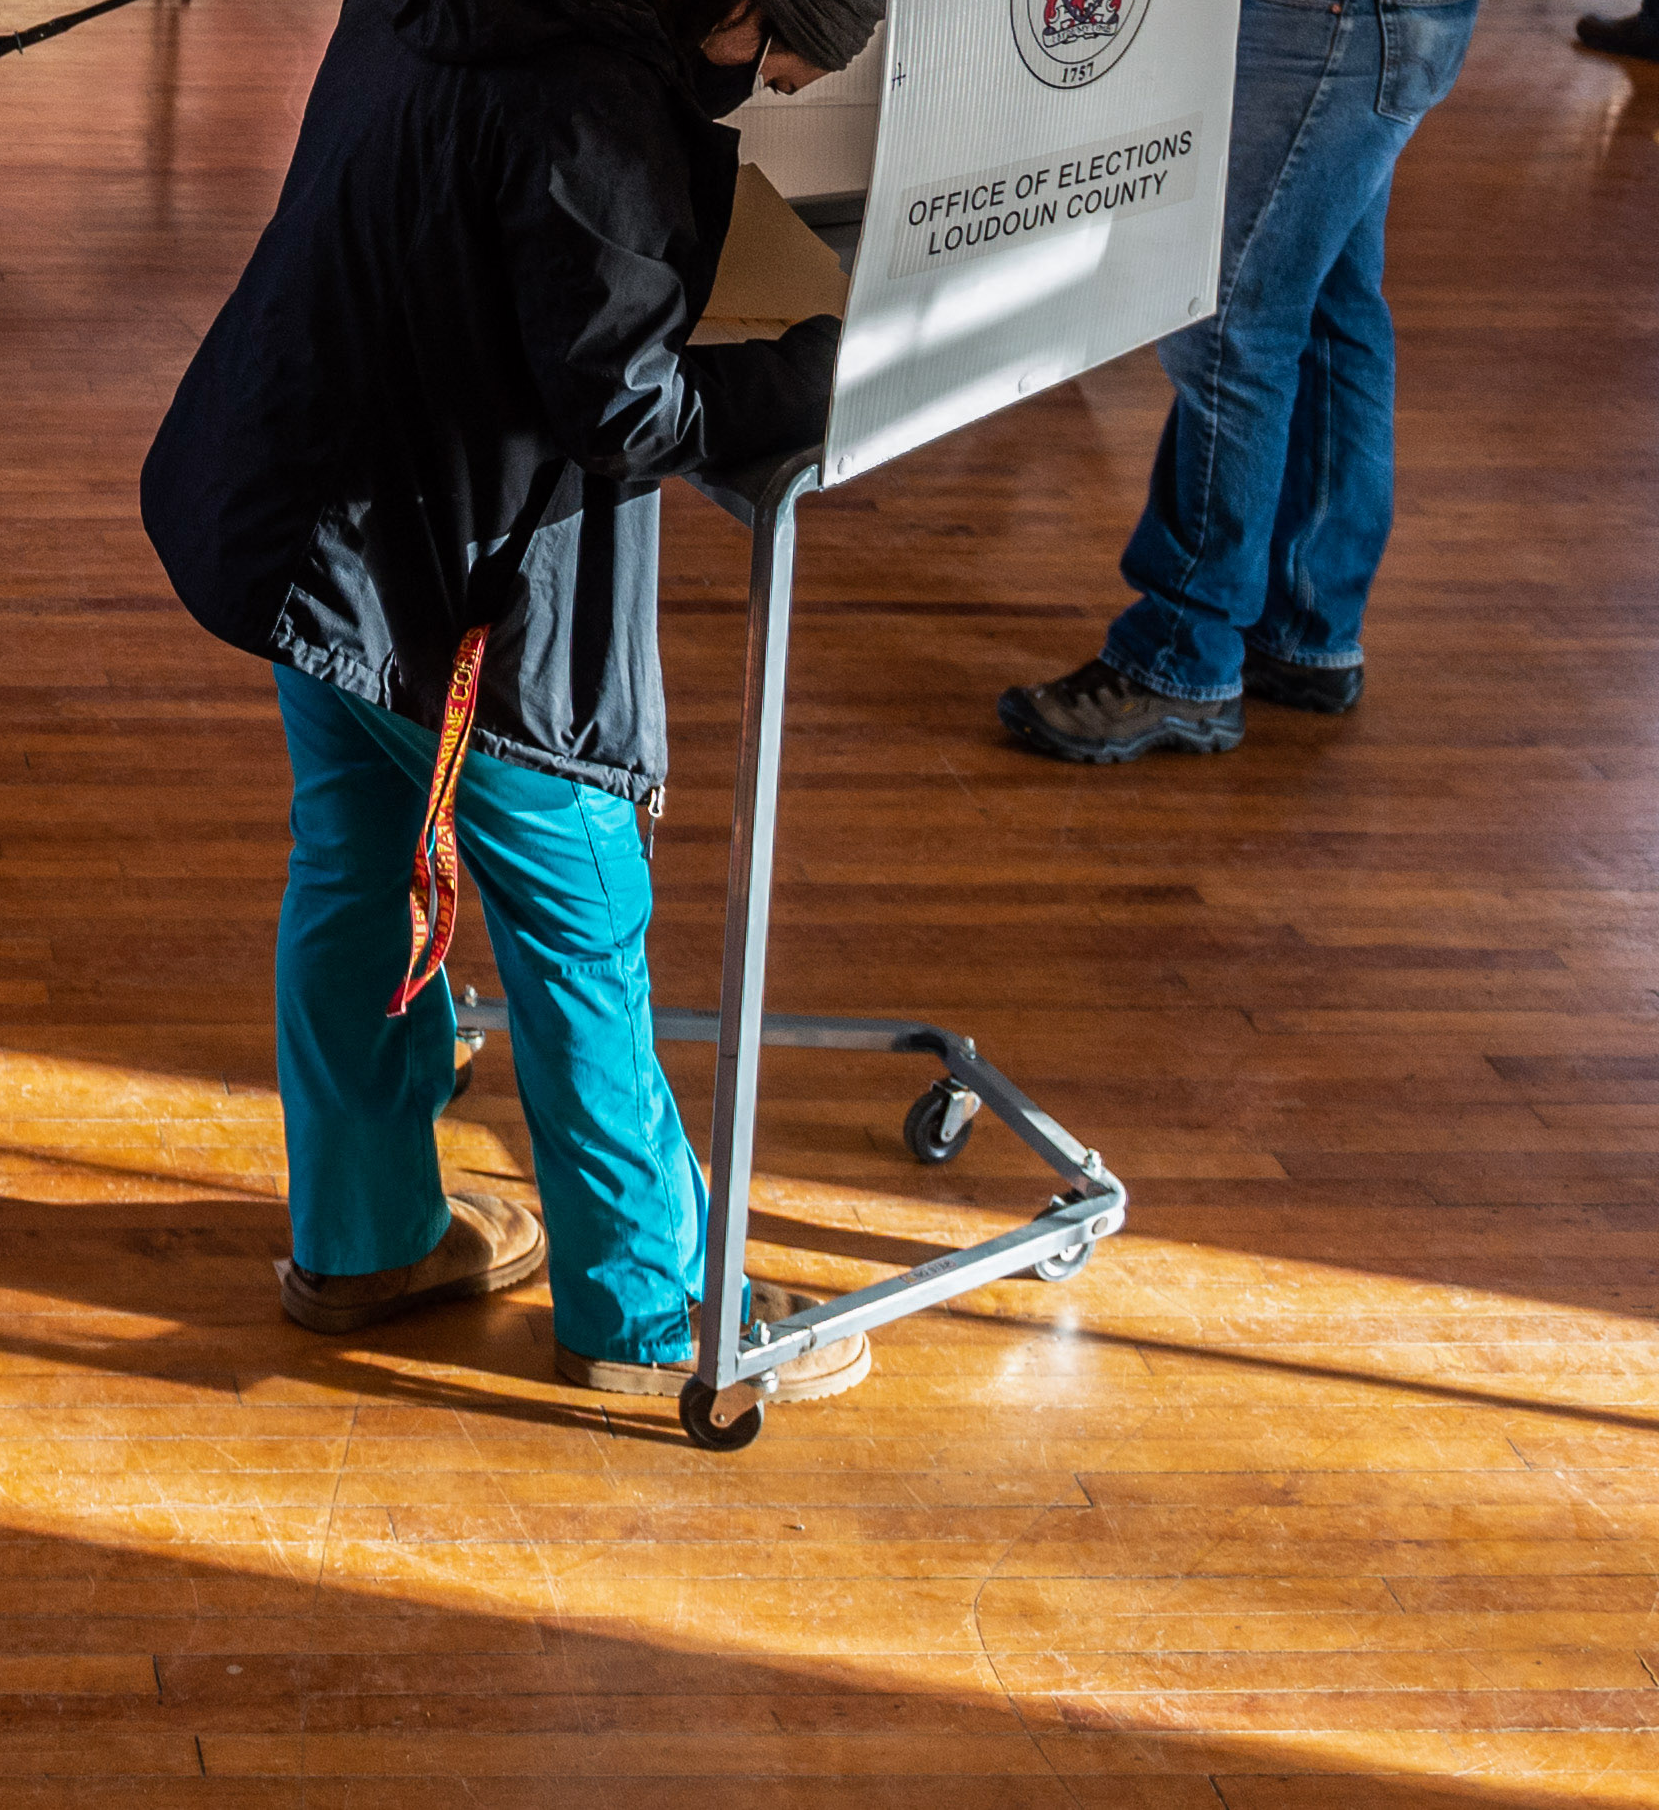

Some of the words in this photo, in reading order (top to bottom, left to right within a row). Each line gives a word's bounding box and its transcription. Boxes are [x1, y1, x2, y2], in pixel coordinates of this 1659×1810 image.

[1062, 62, 1094, 82] 1757
[909, 181, 1006, 225] OFFICE
[1015, 170, 1050, 199] OF
[1058, 130, 1192, 189] ELECTIONS
[928, 201, 1057, 255] LOUDOUN
[1067, 170, 1168, 219] COUNTY
[430, 705, 466, 802] MARINE
